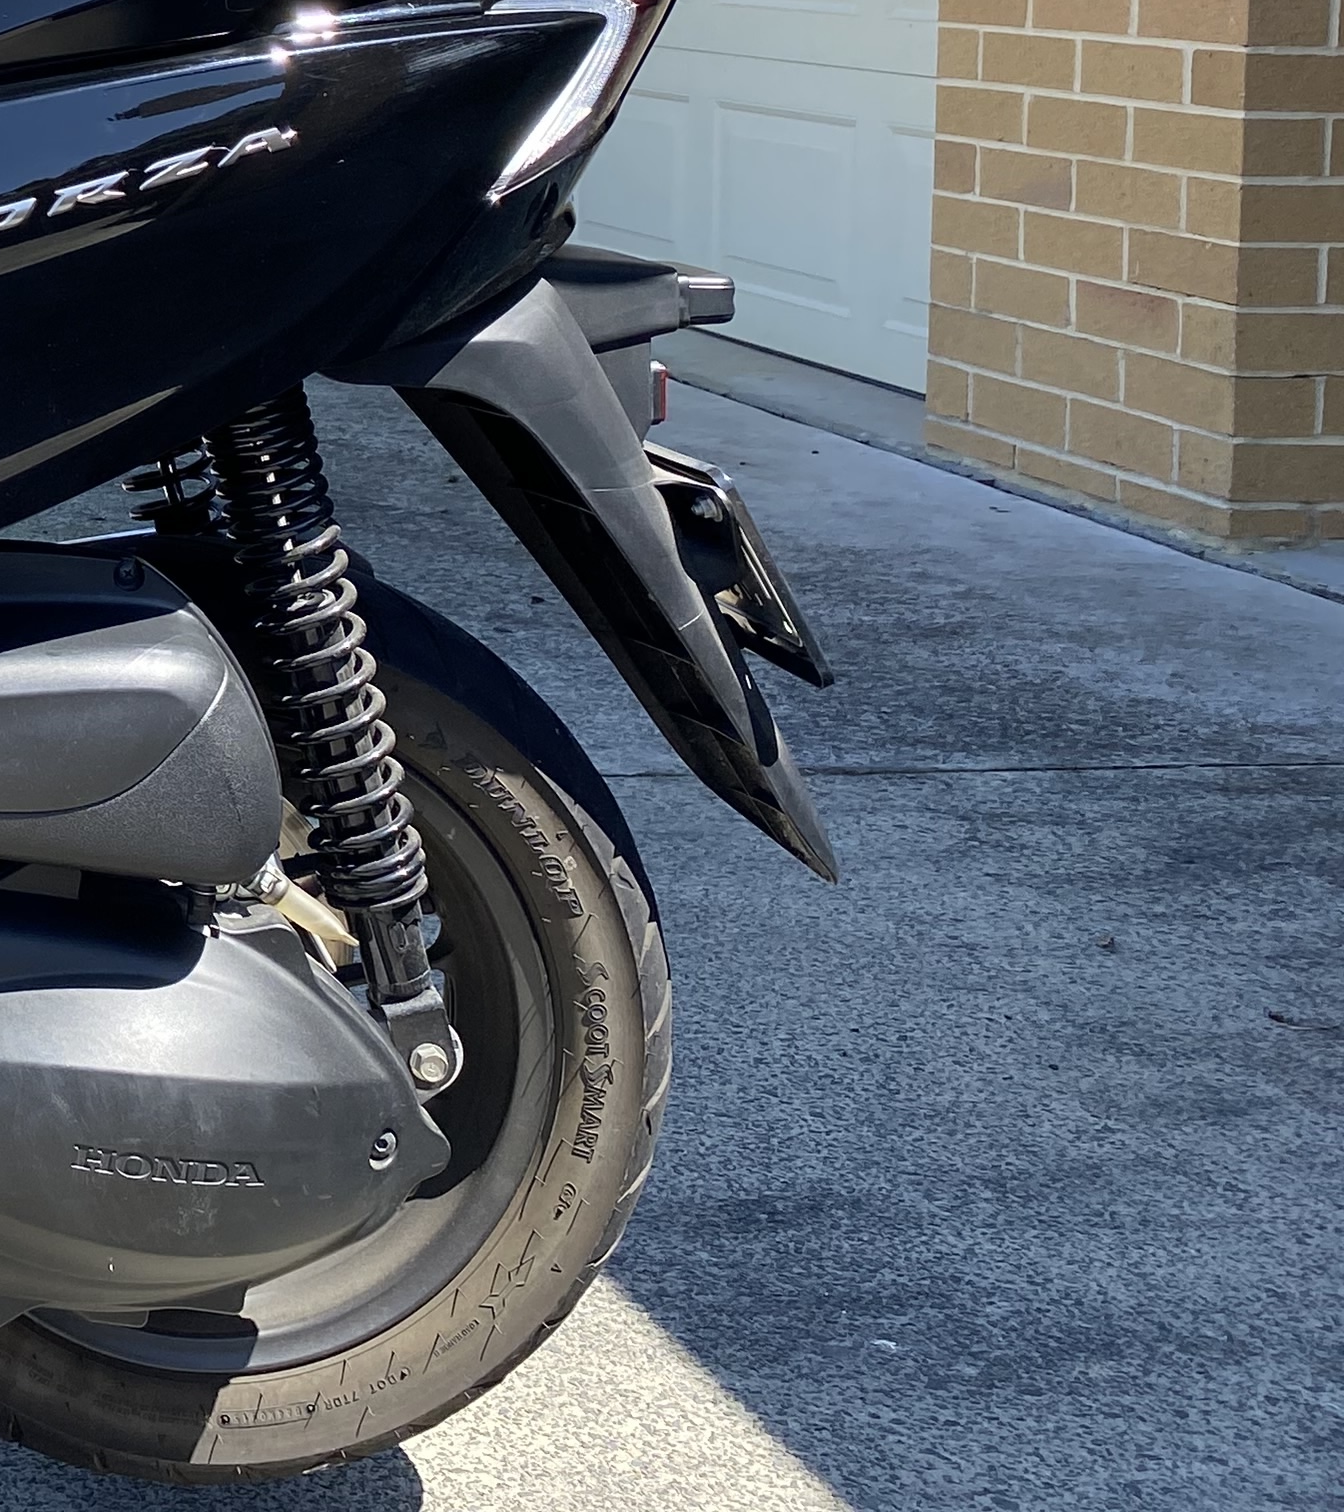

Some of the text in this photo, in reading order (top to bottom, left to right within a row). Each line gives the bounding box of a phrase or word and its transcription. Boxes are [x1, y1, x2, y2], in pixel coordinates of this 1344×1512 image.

[462, 757, 585, 916] DUNLOP
[70, 1143, 265, 1187] HONDA
[369, 1374, 397, 1395] DOT
